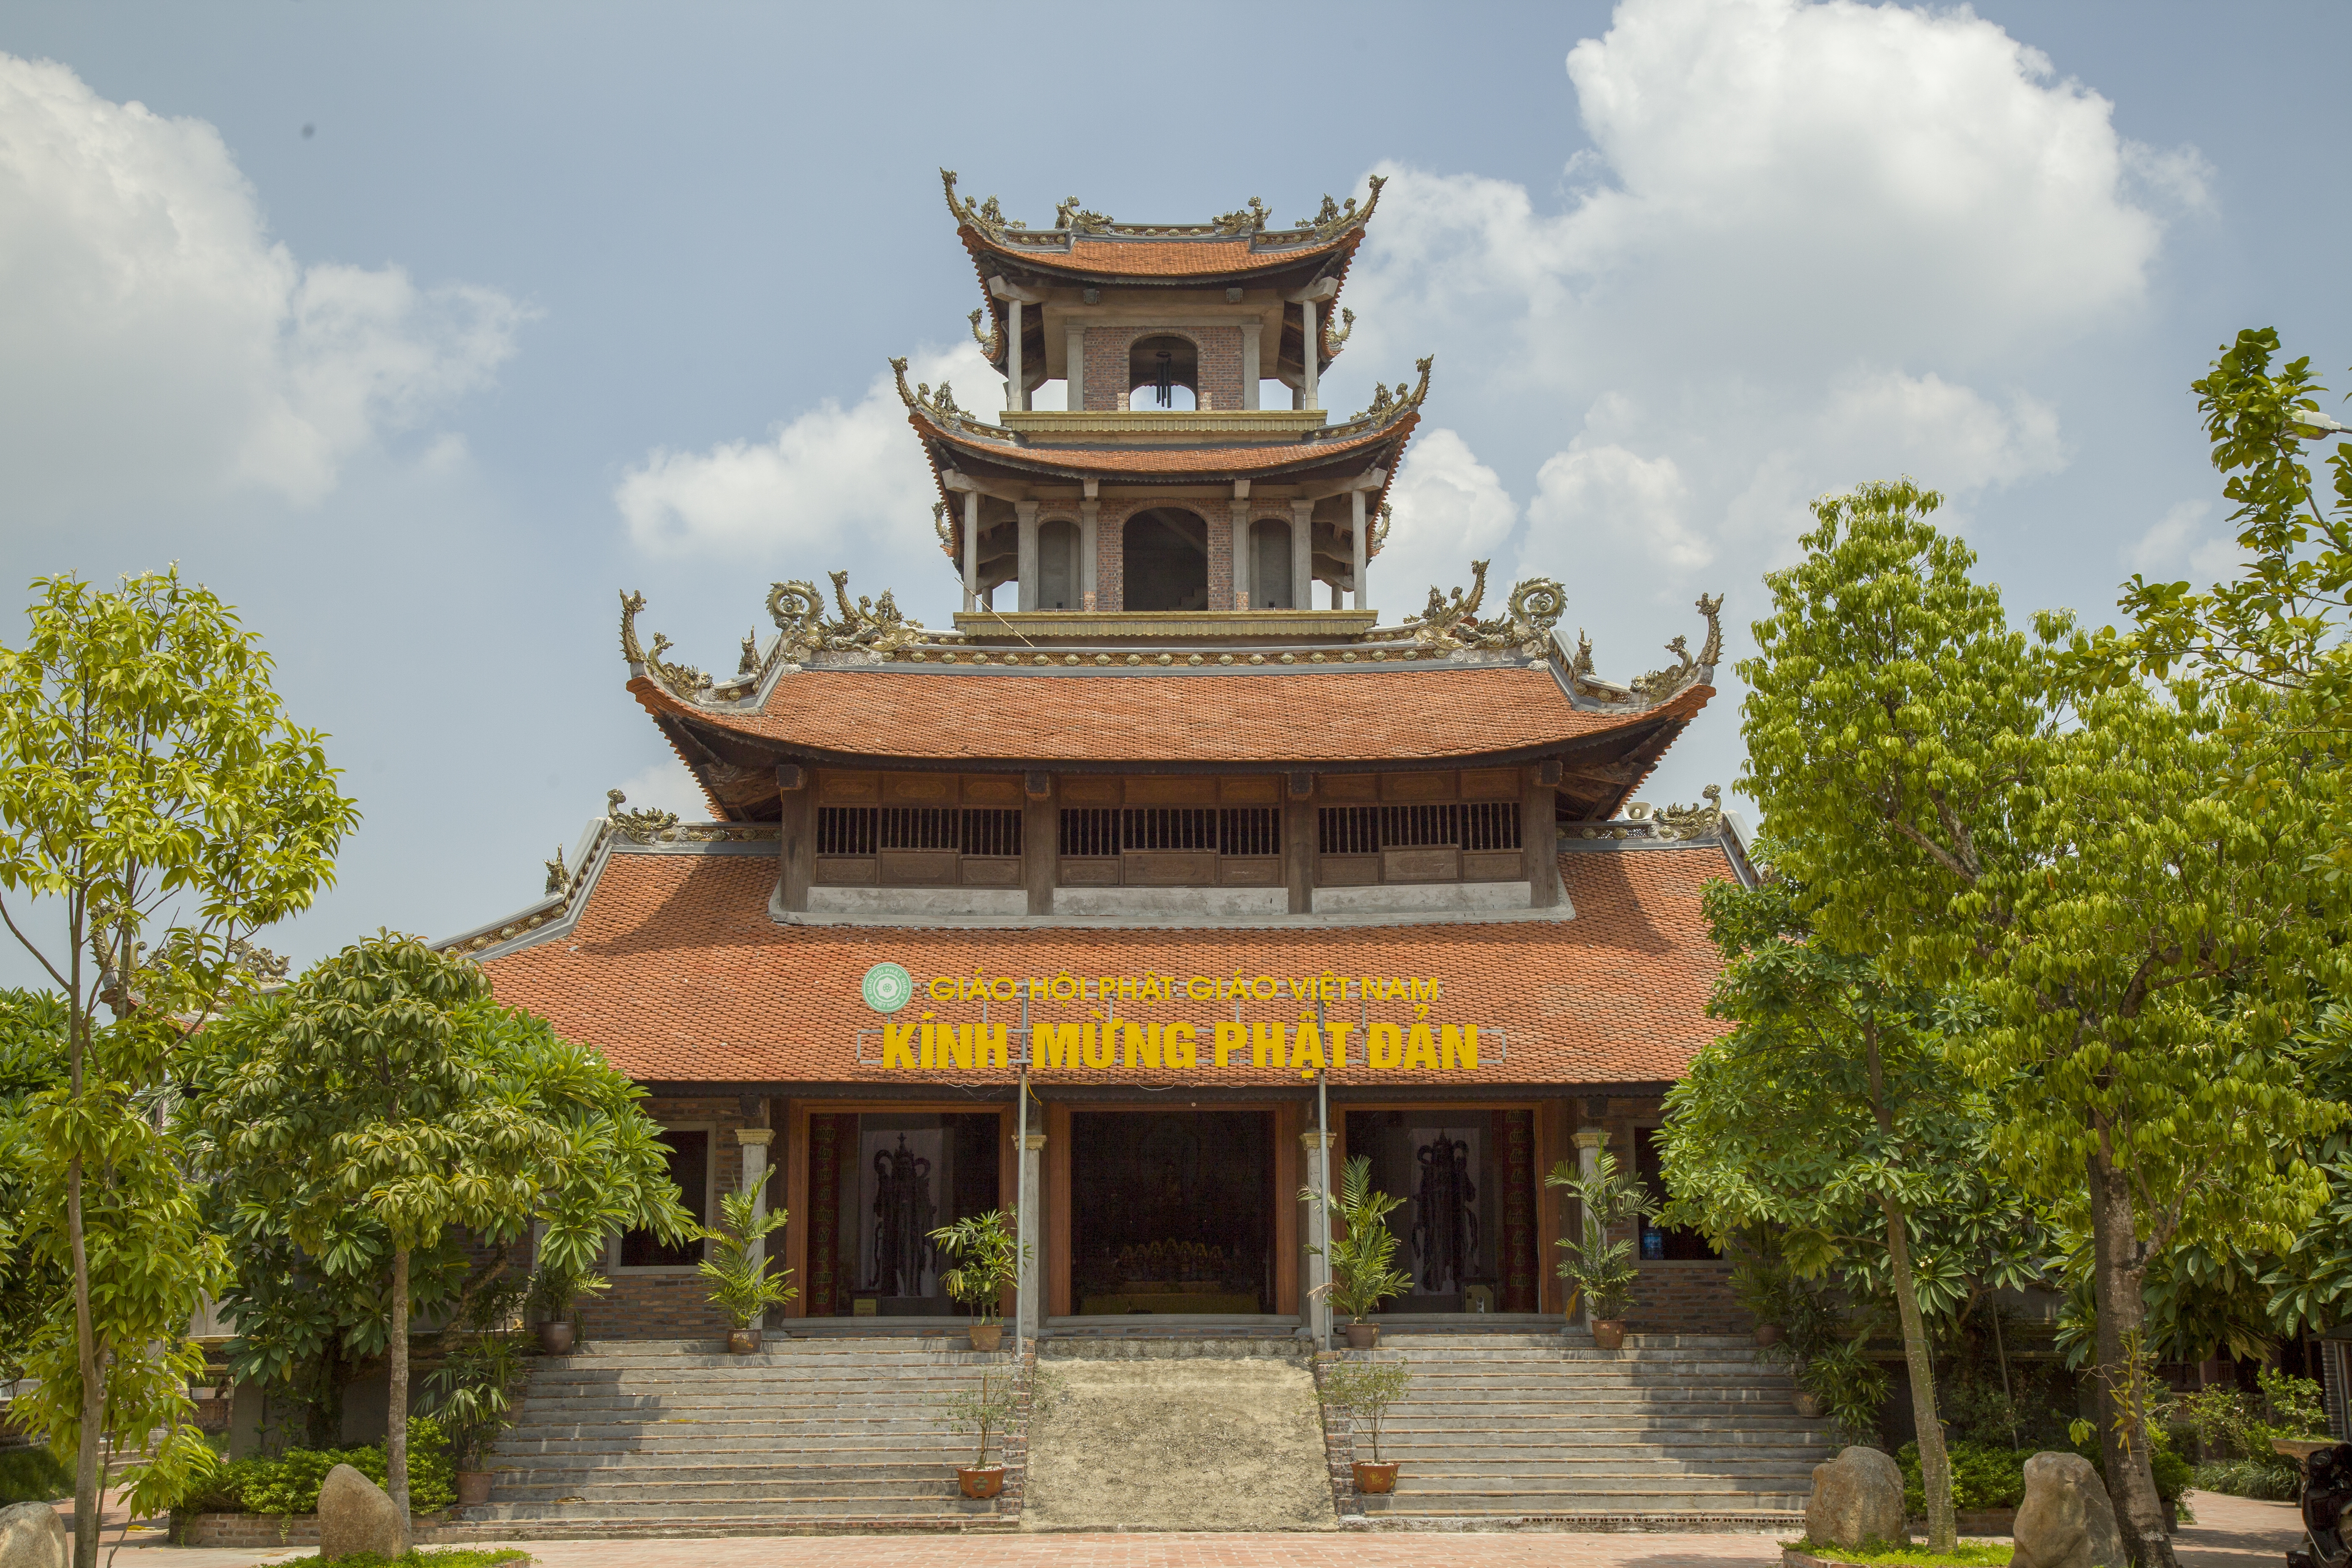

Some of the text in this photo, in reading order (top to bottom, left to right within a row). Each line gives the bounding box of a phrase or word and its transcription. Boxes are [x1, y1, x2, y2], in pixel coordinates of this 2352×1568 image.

[873, 969, 884, 978] HỘI
[885, 968, 903, 977] PHẬT
[929, 967, 1438, 1008] GIÁO HỘI PHẬT GIÁO VIỆT NAM
[874, 999, 900, 1008] VIỆT NAM
[883, 1004, 1478, 1078] KÍNH MỪNG PHẬT ĐẢN
